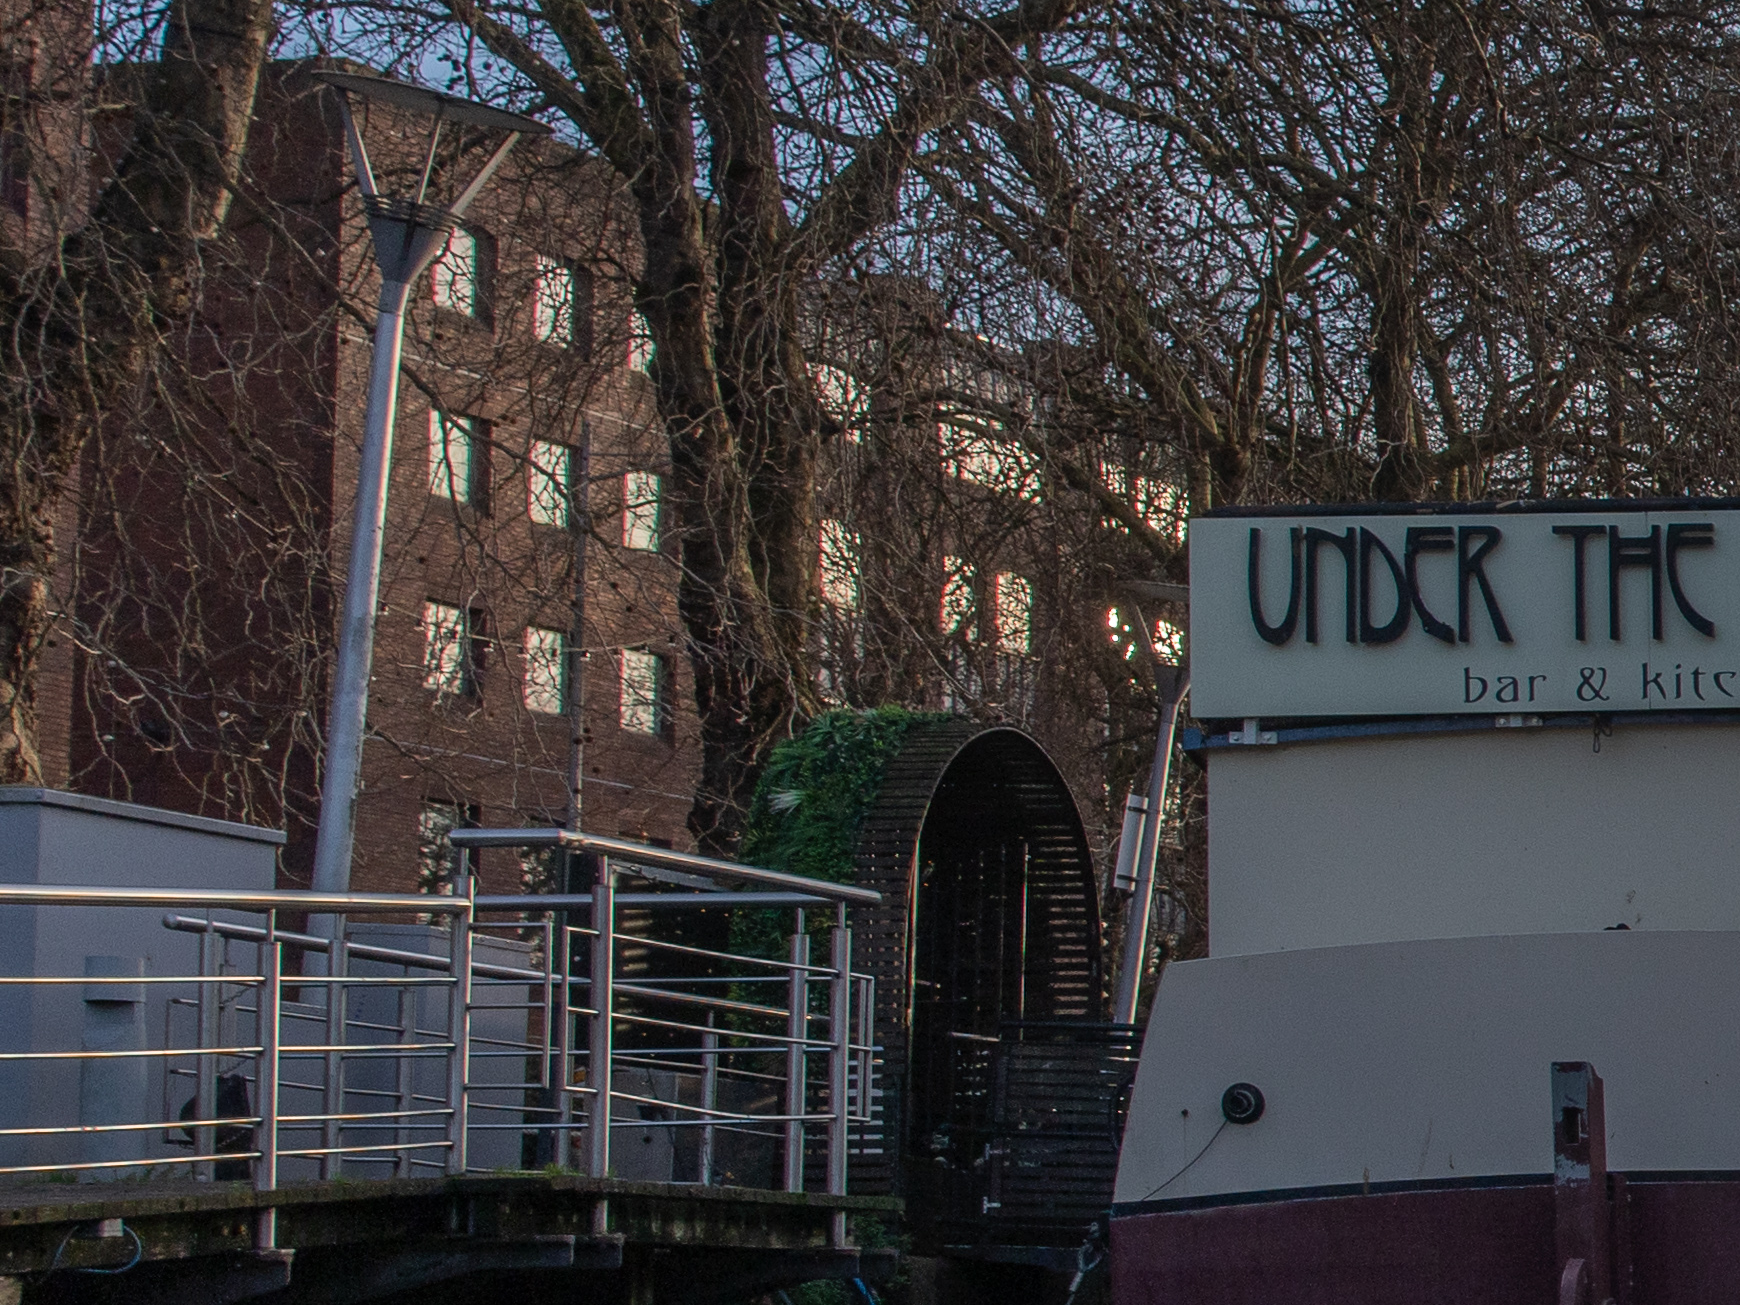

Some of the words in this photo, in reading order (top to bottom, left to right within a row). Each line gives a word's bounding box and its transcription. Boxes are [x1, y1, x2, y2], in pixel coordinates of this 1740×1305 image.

[1249, 524, 1513, 646] UNDER
[1552, 521, 1715, 642] THE
[1463, 665, 1548, 705] bar
[1575, 665, 1612, 704] &
